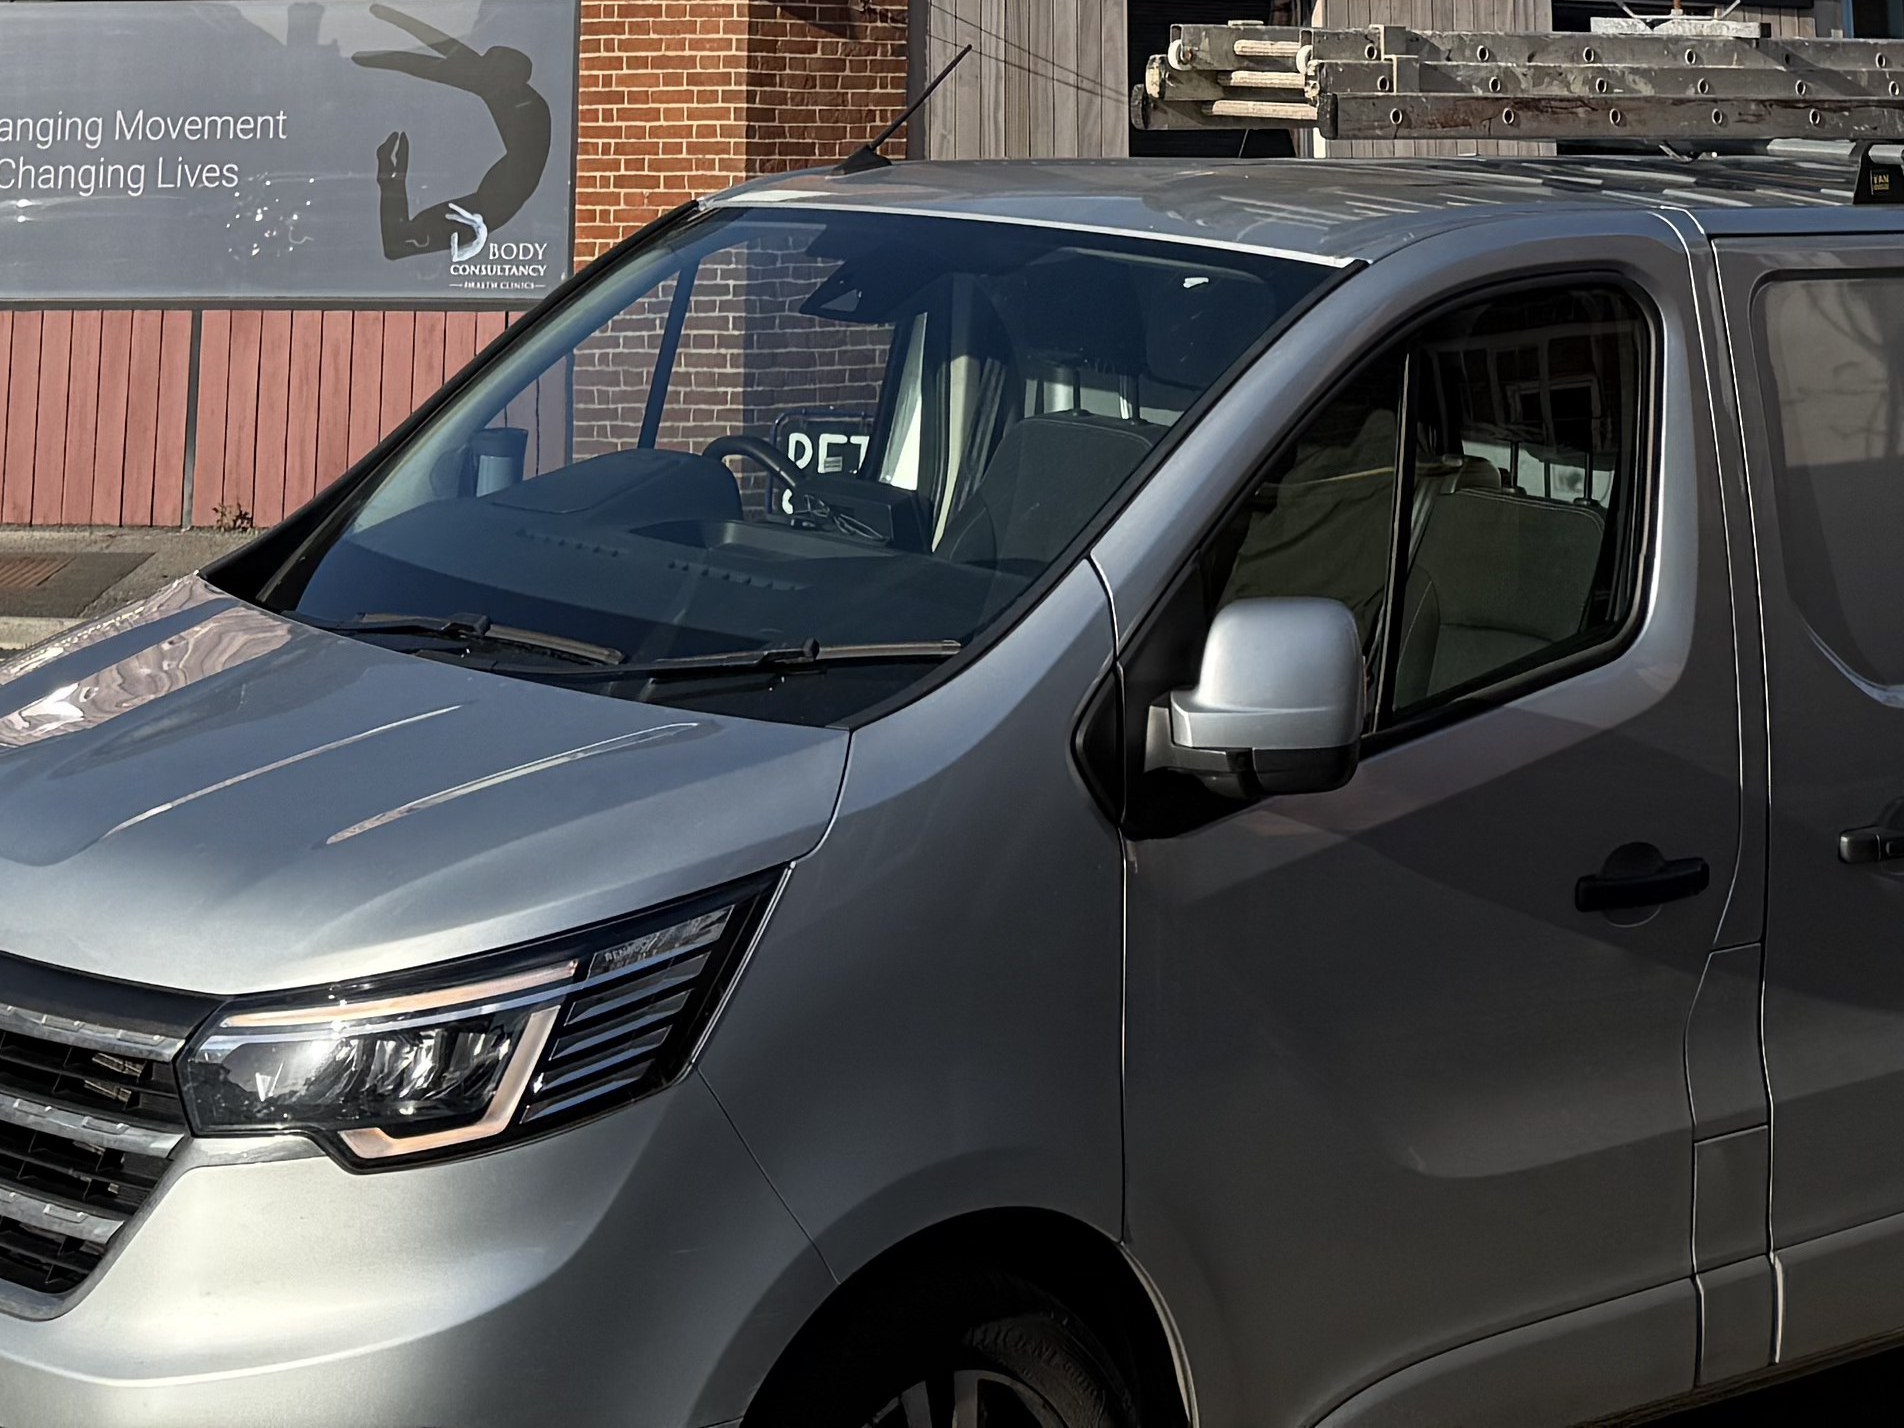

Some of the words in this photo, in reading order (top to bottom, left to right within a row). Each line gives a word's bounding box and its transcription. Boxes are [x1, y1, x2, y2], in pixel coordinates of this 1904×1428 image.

[114, 109, 287, 143] Movement
[158, 156, 239, 190] Lives
[489, 243, 548, 260] BODY
[450, 264, 547, 276] CONSULTANCY
